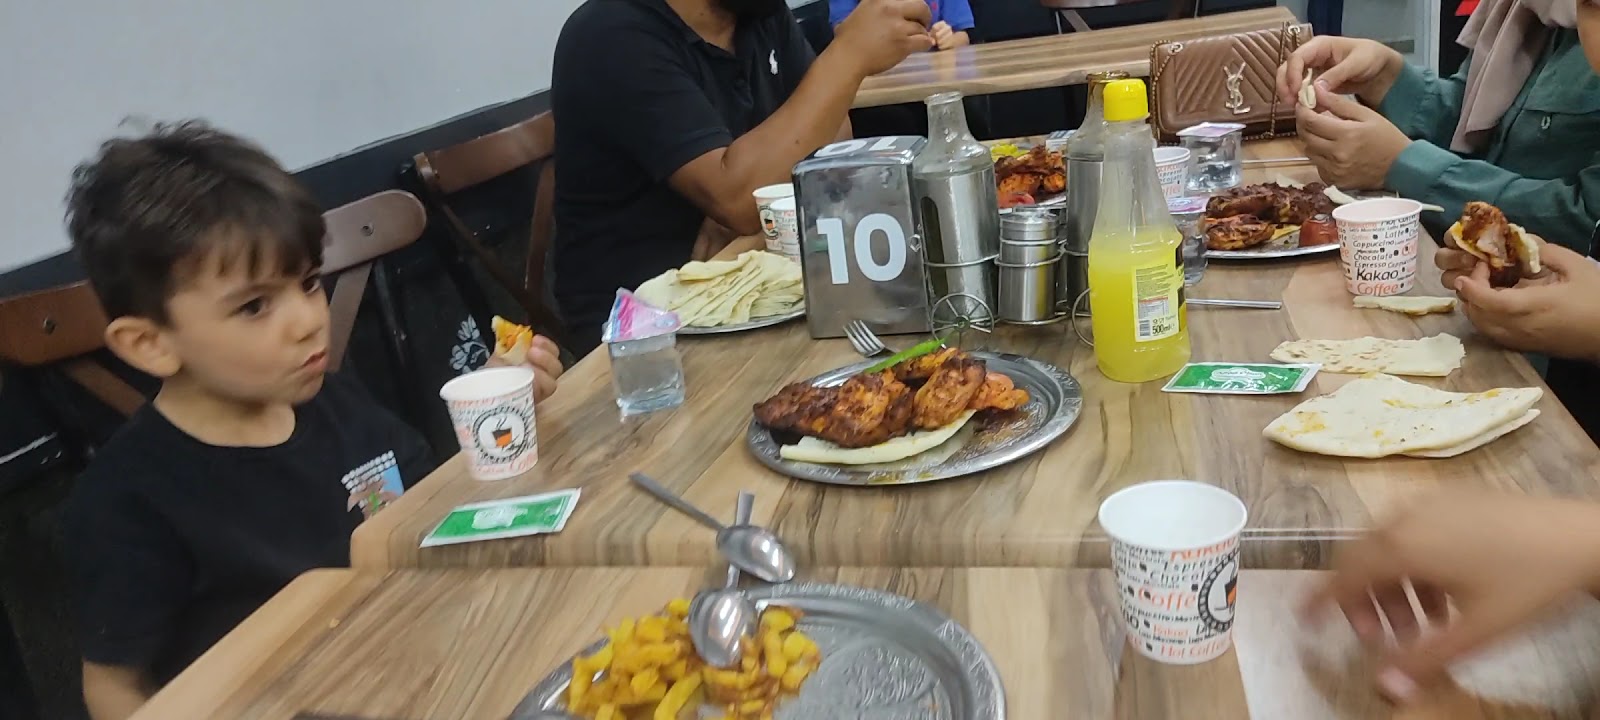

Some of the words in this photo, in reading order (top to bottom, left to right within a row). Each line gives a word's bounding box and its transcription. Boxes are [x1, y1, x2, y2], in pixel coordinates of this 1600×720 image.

[816, 213, 907, 285] 10
[1354, 260, 1387, 269] Espresso
[1356, 268, 1399, 282] Kakao
[1357, 282, 1399, 296] Coffee
